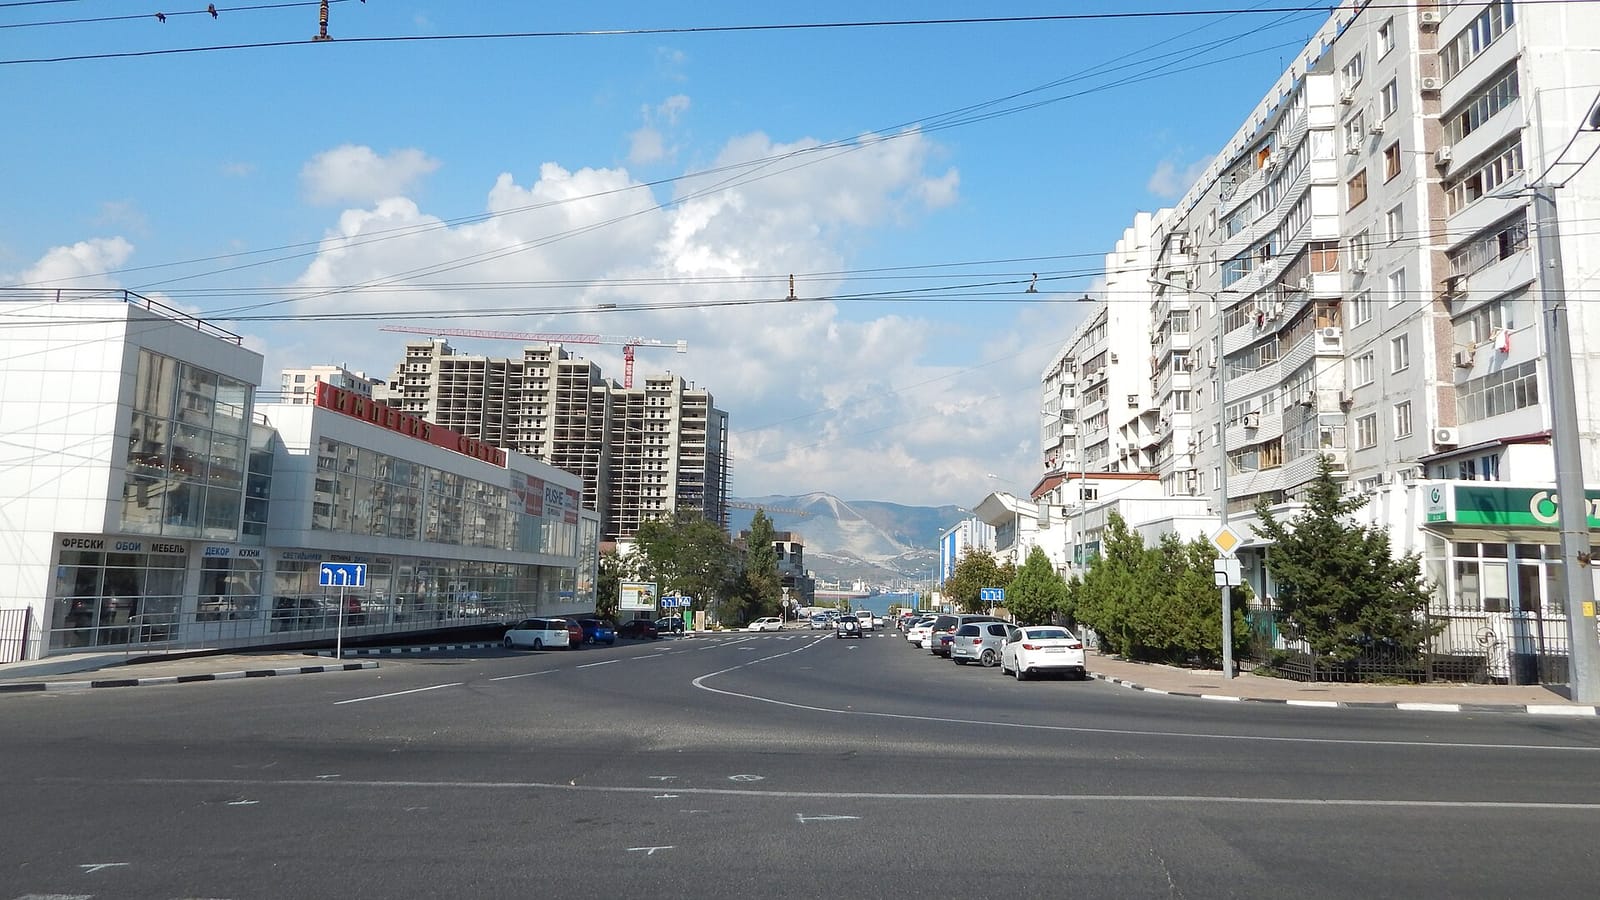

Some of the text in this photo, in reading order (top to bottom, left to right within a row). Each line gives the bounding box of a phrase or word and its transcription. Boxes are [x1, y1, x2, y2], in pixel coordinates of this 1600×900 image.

[336, 389, 432, 440] ИМПЕРИЯ
[62, 538, 185, 553] ФРЕСКИ ОБОИ МЕБЕЛЬ
[205, 546, 261, 557] ДЕКОР КУХНИ
